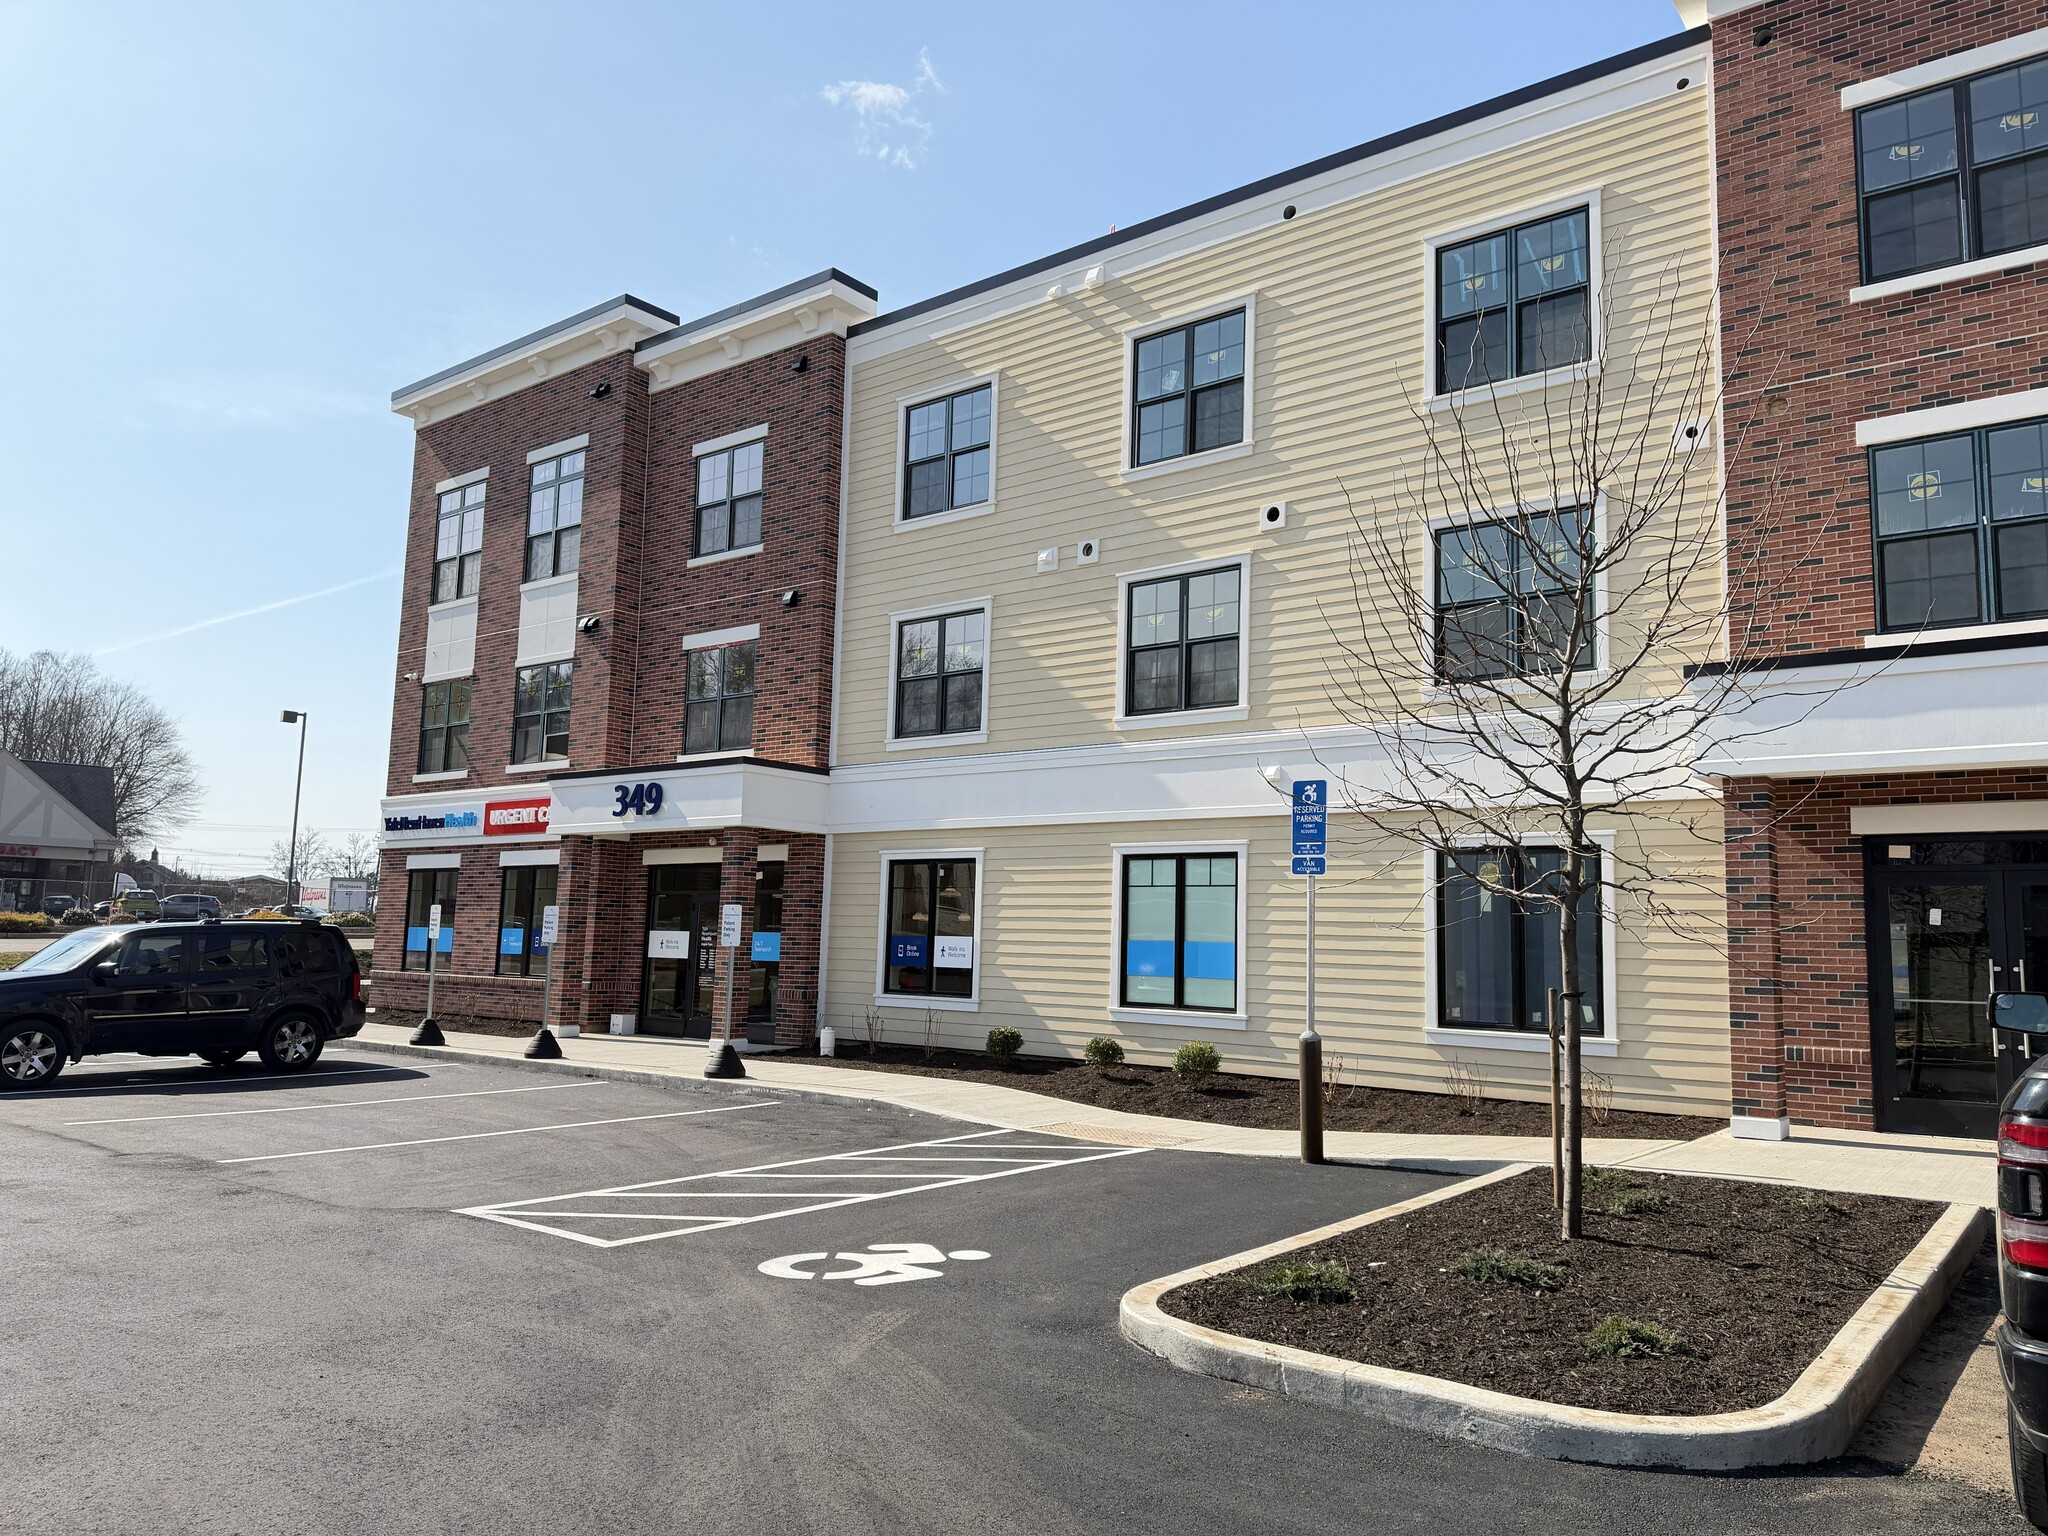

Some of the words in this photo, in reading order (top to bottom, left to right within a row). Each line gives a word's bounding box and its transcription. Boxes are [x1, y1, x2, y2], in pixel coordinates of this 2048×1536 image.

[612, 782, 663, 817] 349
[1294, 805, 1325, 814] RESERVED
[490, 808, 538, 826] URGENT
[1296, 814, 1323, 823] PARKING
